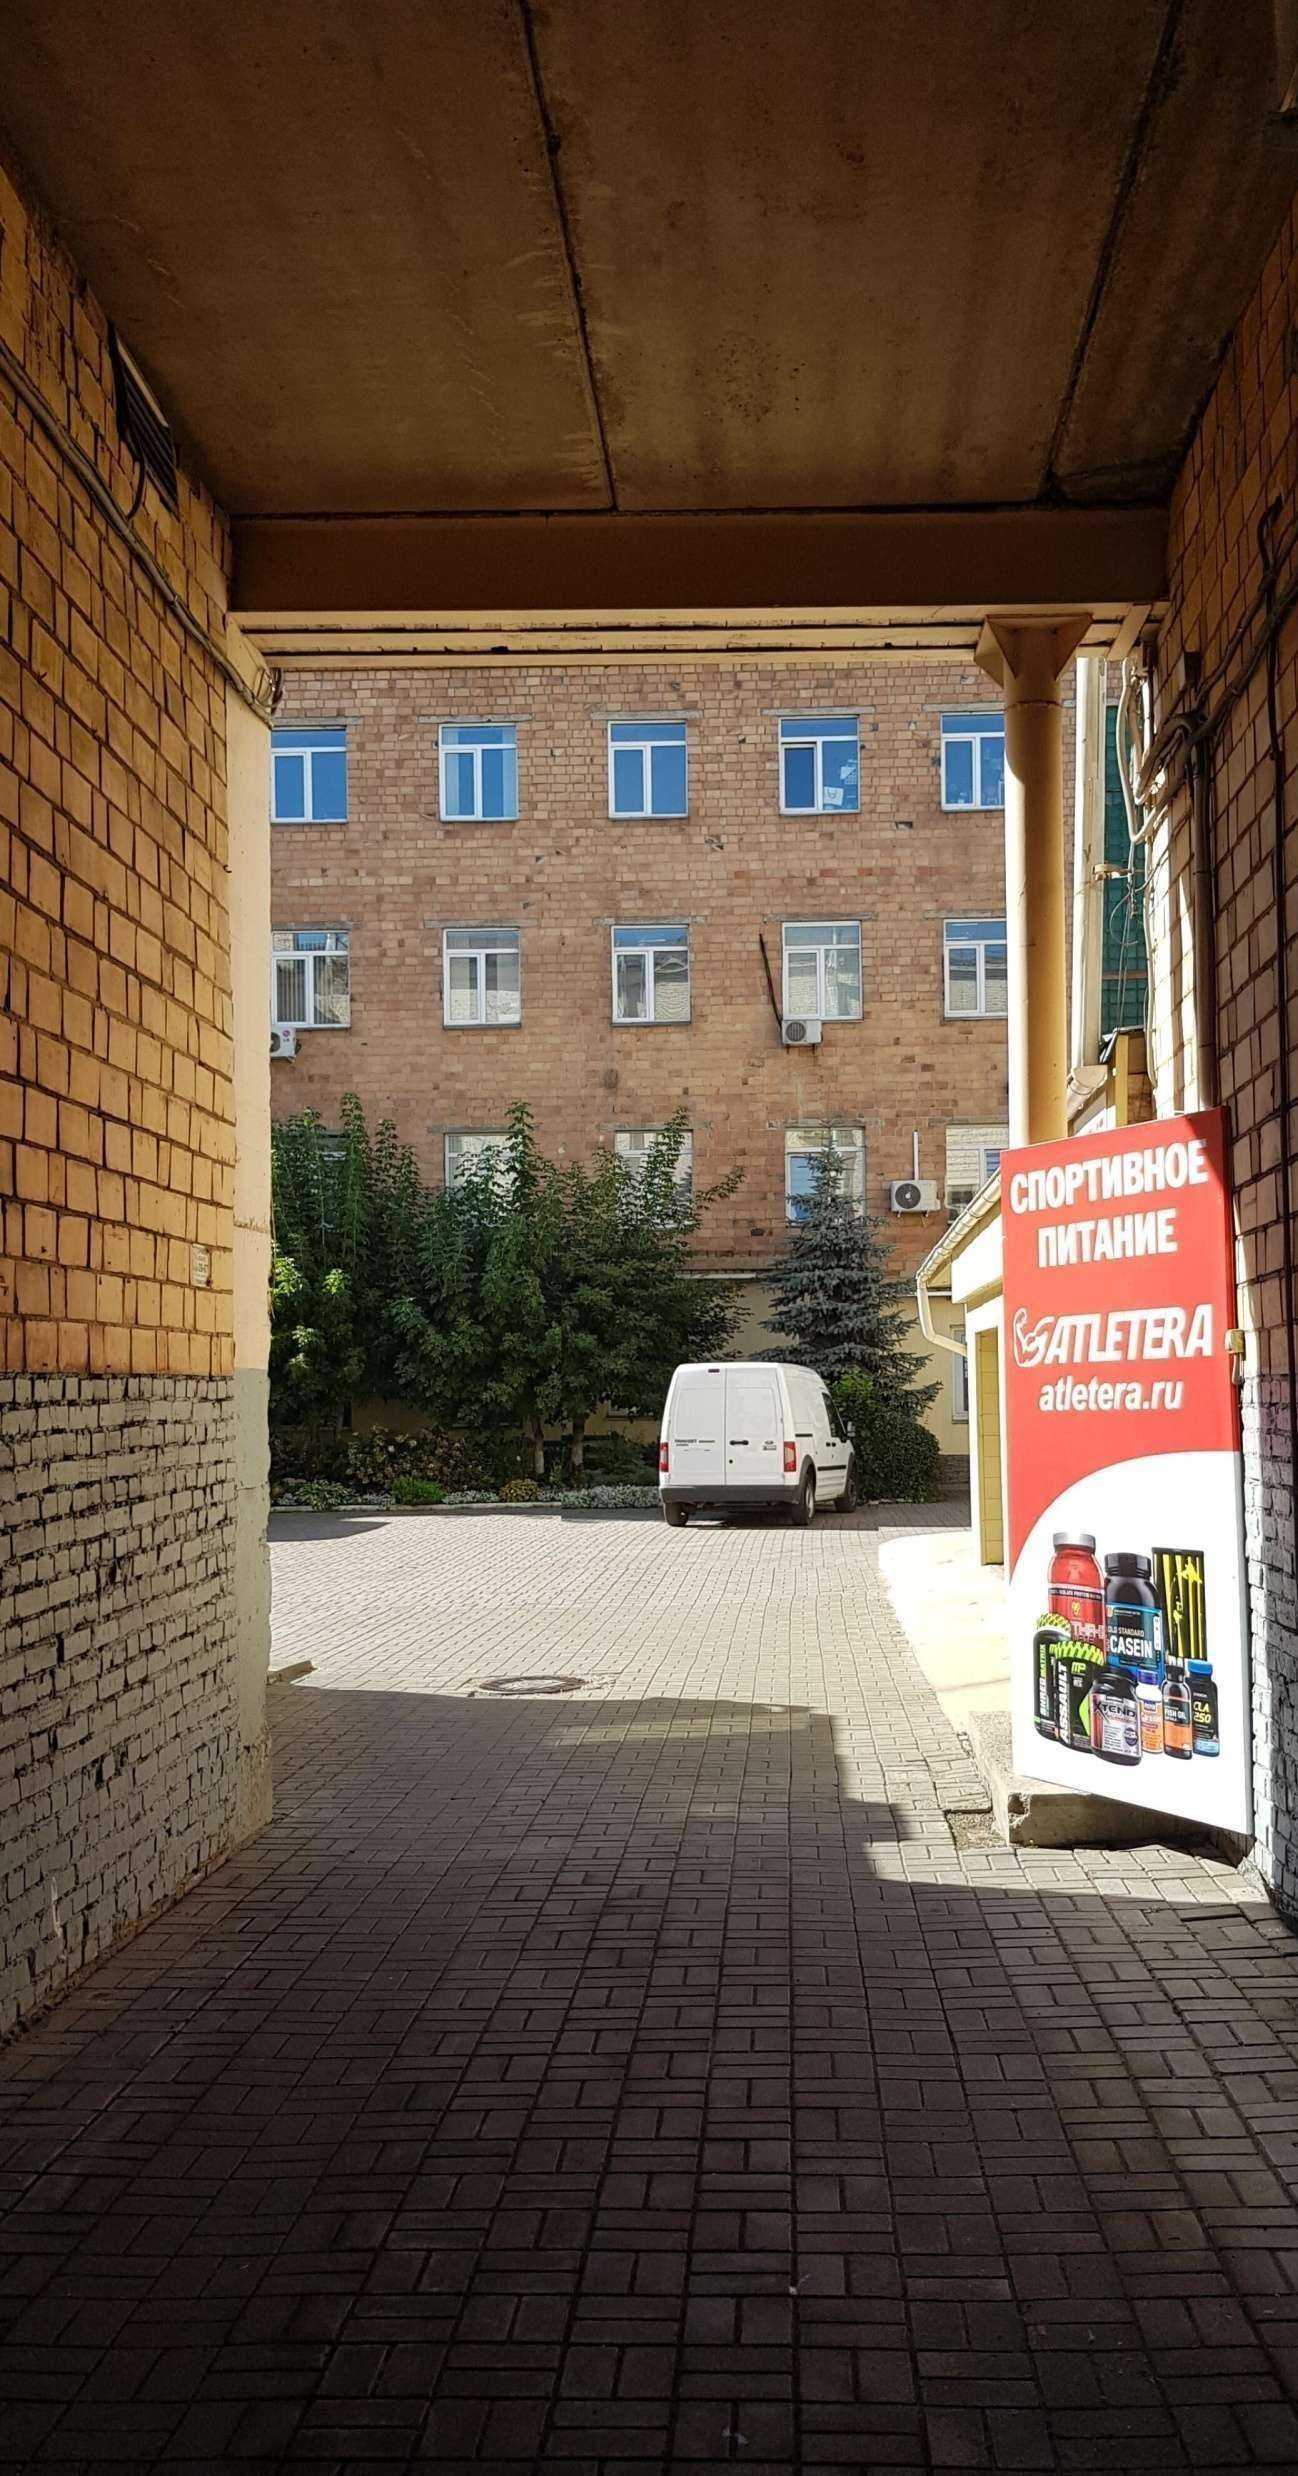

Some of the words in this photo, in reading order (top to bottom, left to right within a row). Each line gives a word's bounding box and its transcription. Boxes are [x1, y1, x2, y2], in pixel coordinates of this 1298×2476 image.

[1010, 1138, 1208, 1214] СПОРТИВНОЕ
[1037, 1208, 1178, 1268] ПИТАНИЕ
[1044, 1304, 1213, 1365] ATLETERA
[1039, 1375, 1184, 1411] atletera.ru
[1110, 1635, 1153, 1659] CASEIN
[1058, 1661, 1069, 1744] ASSAULT
[1092, 1696, 1136, 1723] XTEND
[1164, 1708, 1177, 1719] FISH
[1193, 1701, 1210, 1713] CLA
[1193, 1712, 1212, 1724] 250
